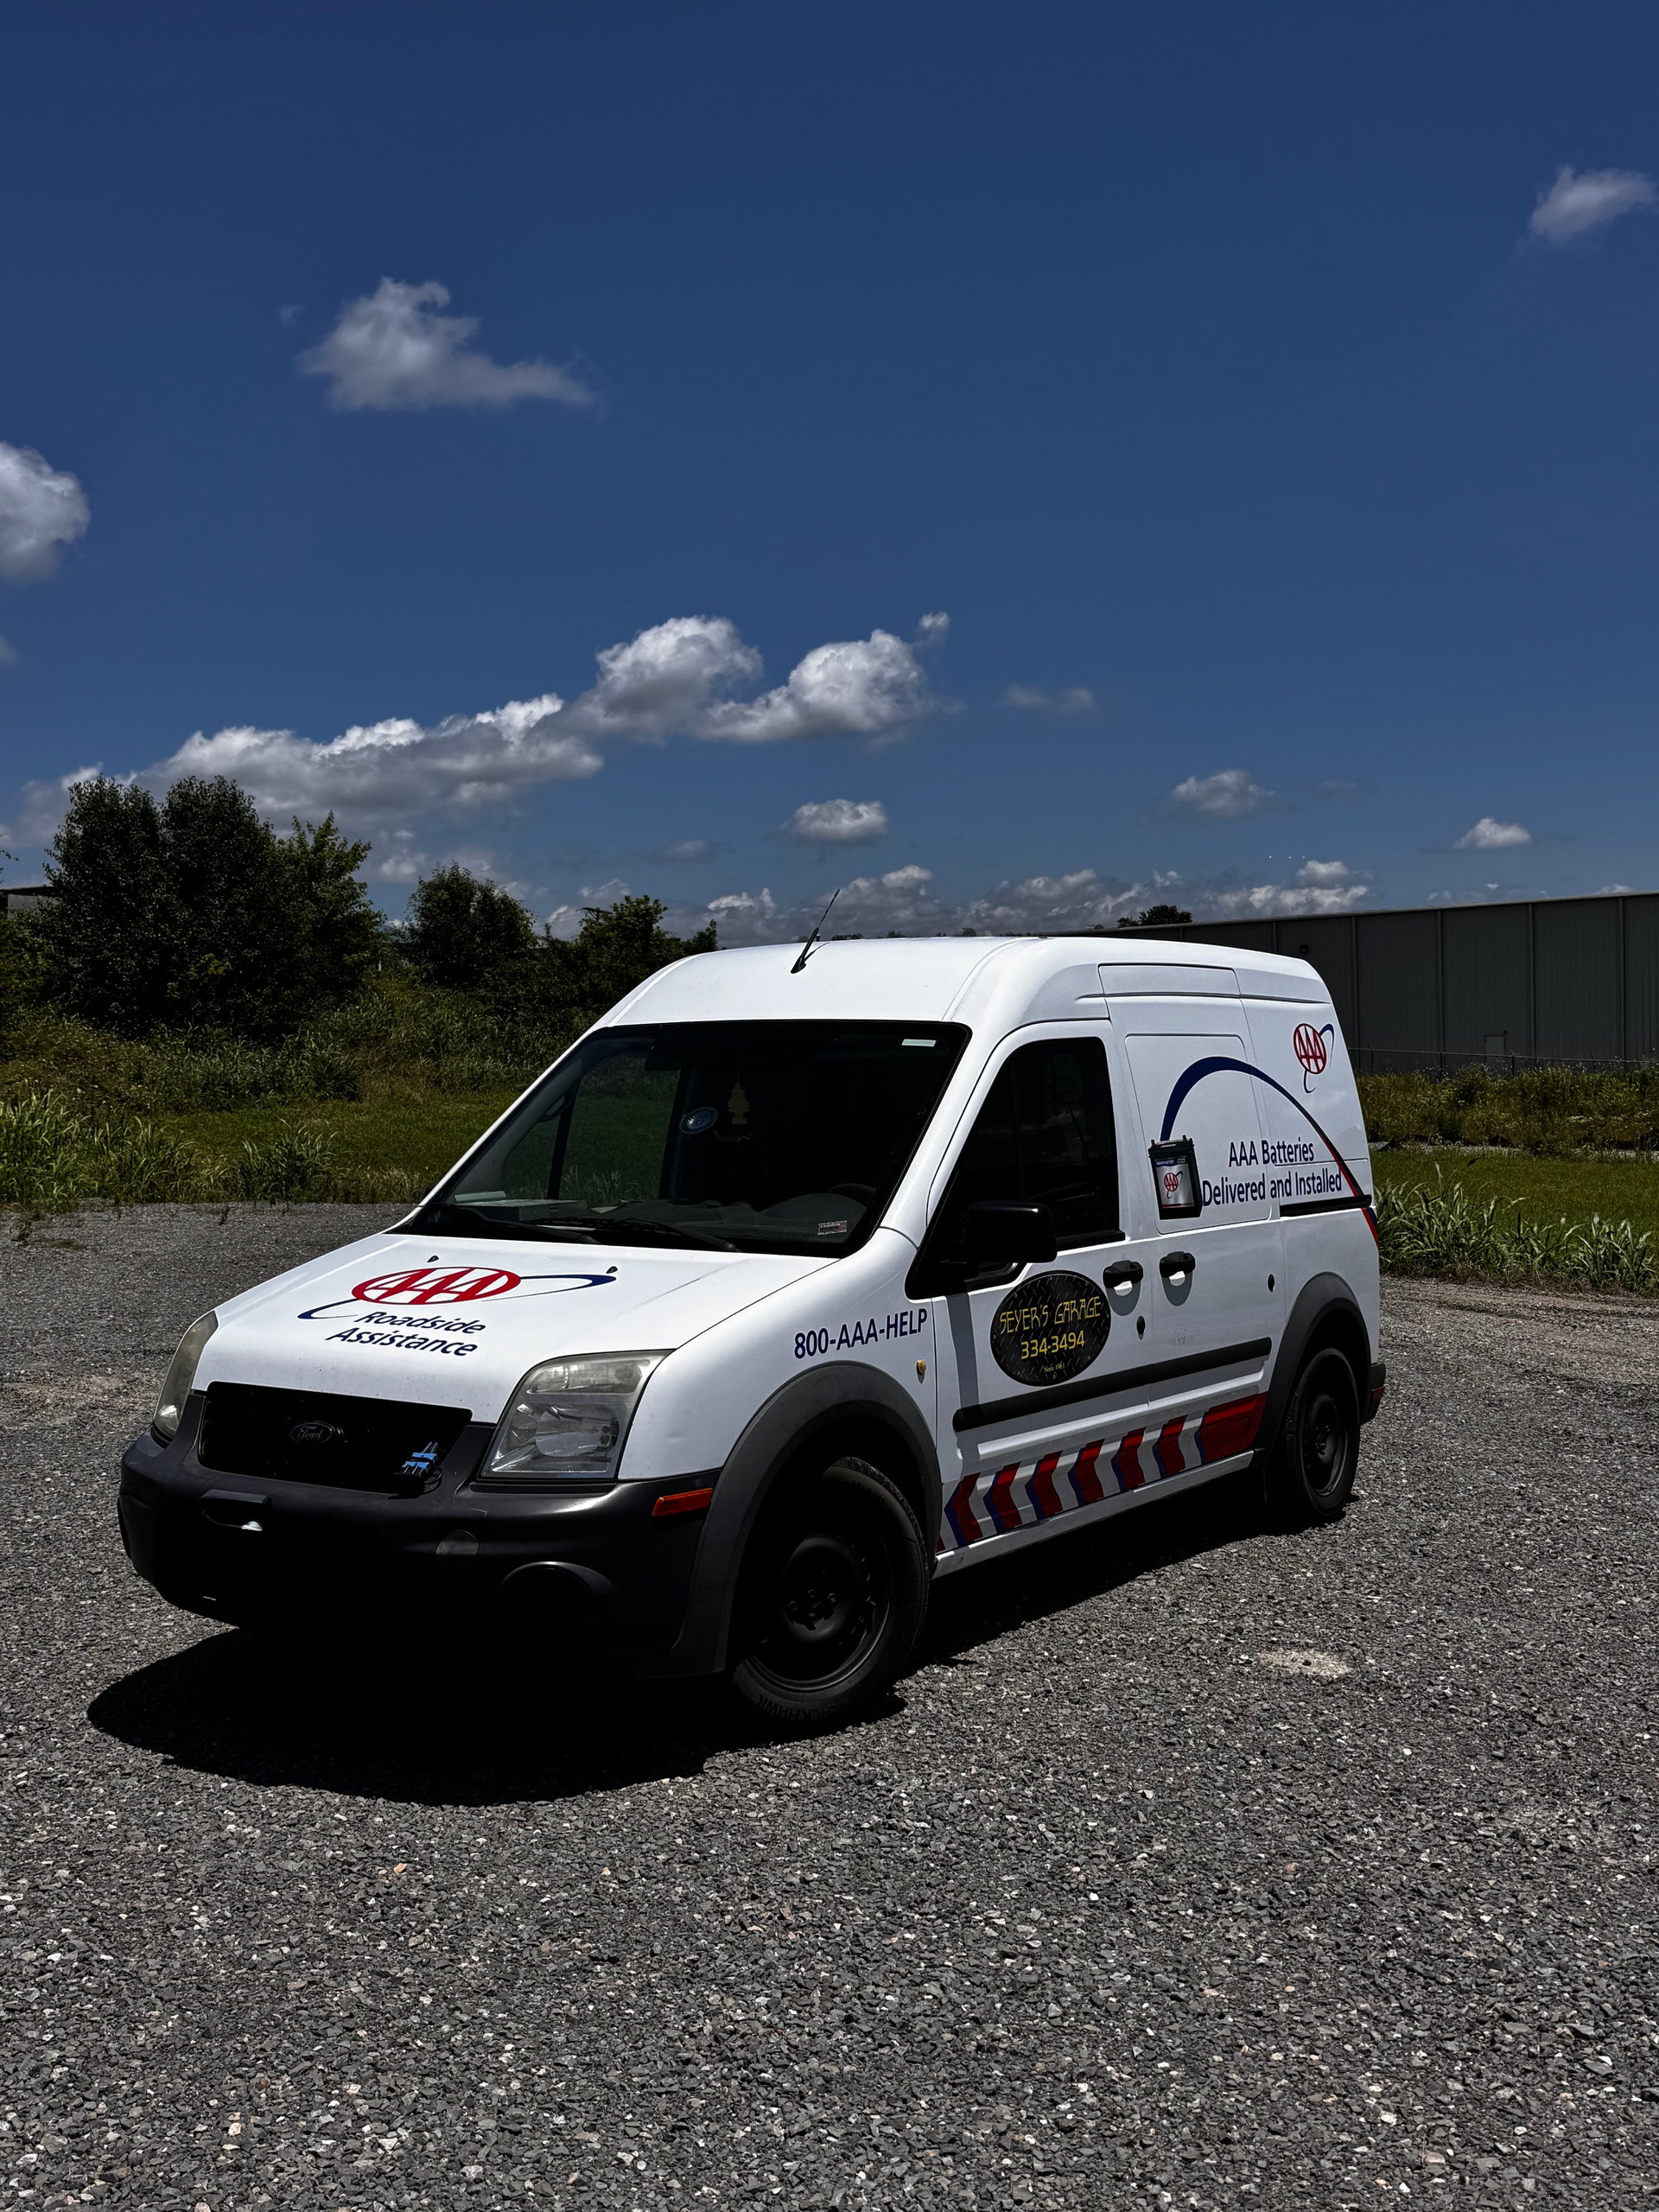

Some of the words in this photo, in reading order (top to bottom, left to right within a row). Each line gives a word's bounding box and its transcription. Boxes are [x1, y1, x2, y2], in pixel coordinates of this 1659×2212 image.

[1294, 1023, 1326, 1074] AAA
[1229, 1141, 1258, 1167] AAA
[1261, 1136, 1314, 1165] Batteries
[1202, 1173, 1266, 1207] Delivered
[1269, 1170, 1292, 1199] and
[1295, 1167, 1342, 1198] Installed
[351, 1266, 521, 1305] AAA
[354, 1311, 486, 1334] Roadside
[1054, 1296, 1102, 1325] GARAGE
[325, 1327, 478, 1357] Assistance
[794, 1307, 928, 1360] 800-AAA-HELP
[1020, 1330, 1085, 1360] 334-3494
[297, 1425, 324, 1441] Ford
